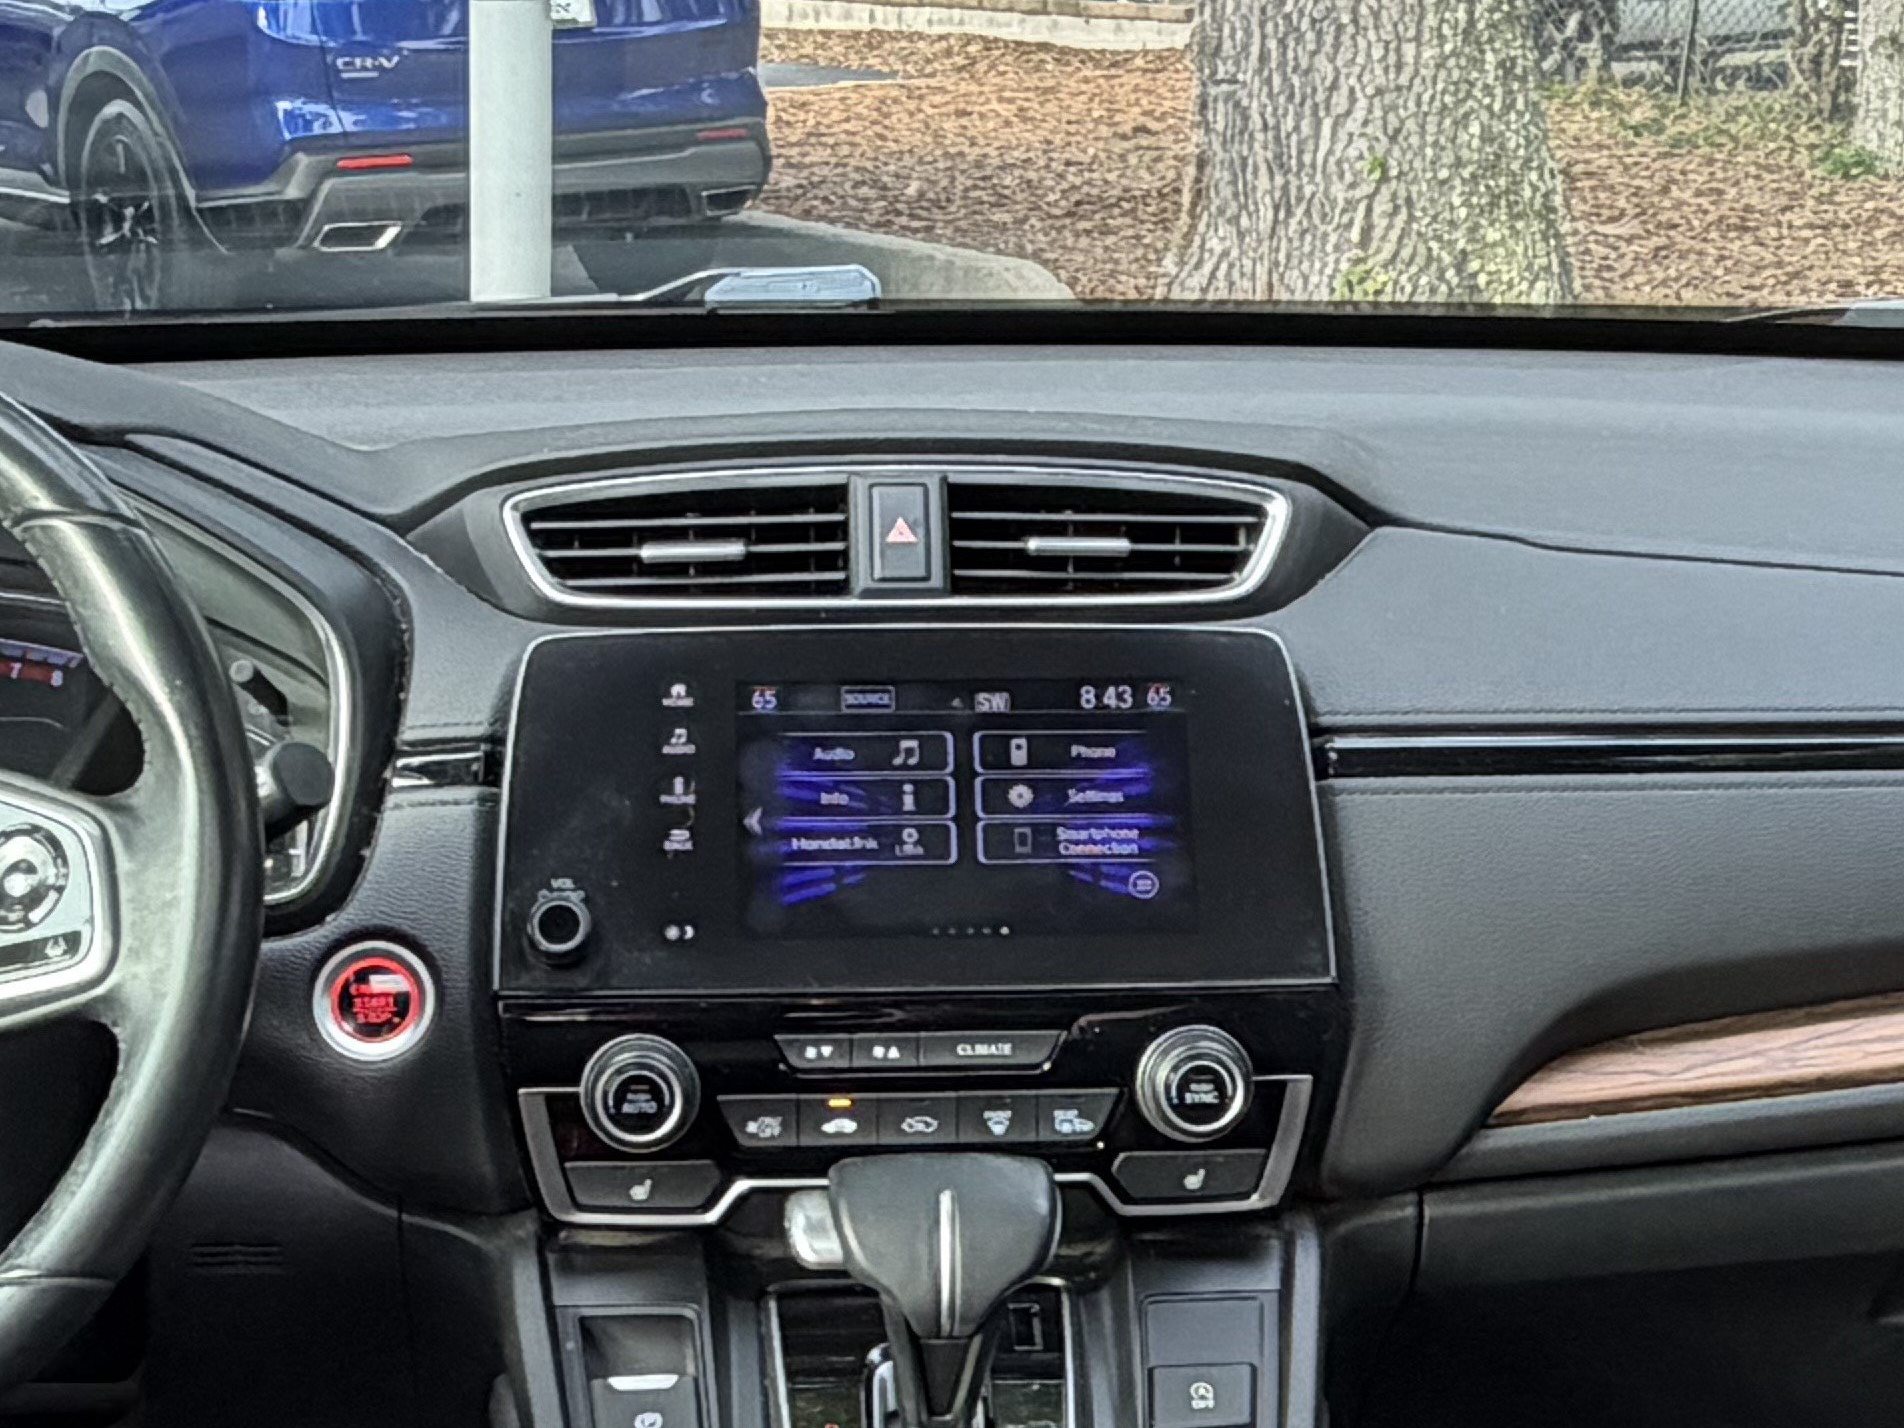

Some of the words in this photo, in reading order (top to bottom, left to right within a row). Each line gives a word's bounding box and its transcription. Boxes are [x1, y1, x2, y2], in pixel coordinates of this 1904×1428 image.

[813, 746, 855, 761] Audio
[1070, 744, 1116, 759] Phone
[956, 1042, 1013, 1056] CLIMATE
[1184, 1091, 1220, 1104] SYNC
[621, 1100, 658, 1114] AUTO
